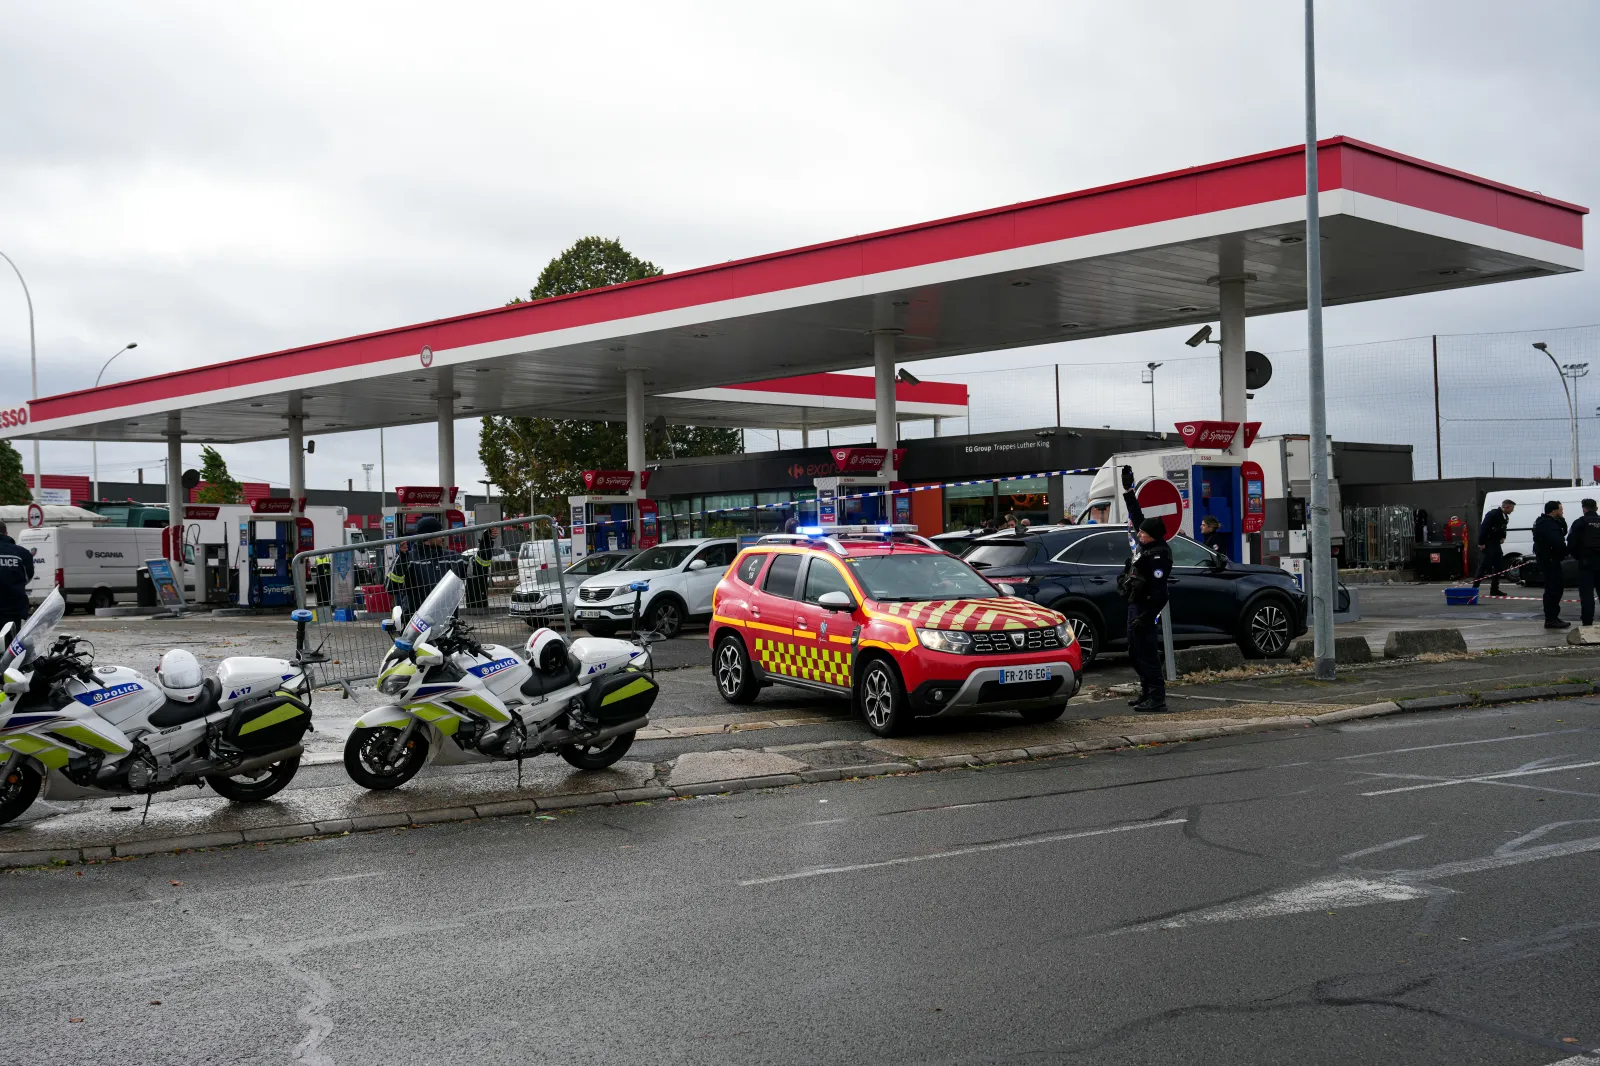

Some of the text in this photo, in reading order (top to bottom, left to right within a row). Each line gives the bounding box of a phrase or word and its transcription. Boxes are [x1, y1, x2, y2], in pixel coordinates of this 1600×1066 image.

[0, 408, 27, 428] SSO
[1209, 431, 1232, 442] Synergy
[1246, 428, 1250, 436] 1
[974, 445, 991, 453] Group
[994, 443, 1016, 452] Trappes
[1017, 441, 1035, 449] Luther
[1037, 440, 1050, 448] King
[859, 456, 882, 466] Synergy
[605, 477, 630, 485] Synergy
[417, 492, 439, 500] Synergy
[0, 558, 19, 567] LICE
[413, 616, 428, 631] LICE
[11, 640, 23, 655] ICE
[489, 659, 516, 673] POLICE
[1005, 669, 1046, 682] FR-216-EG
[103, 684, 138, 699] POLICE
[240, 686, 252, 695] 17
